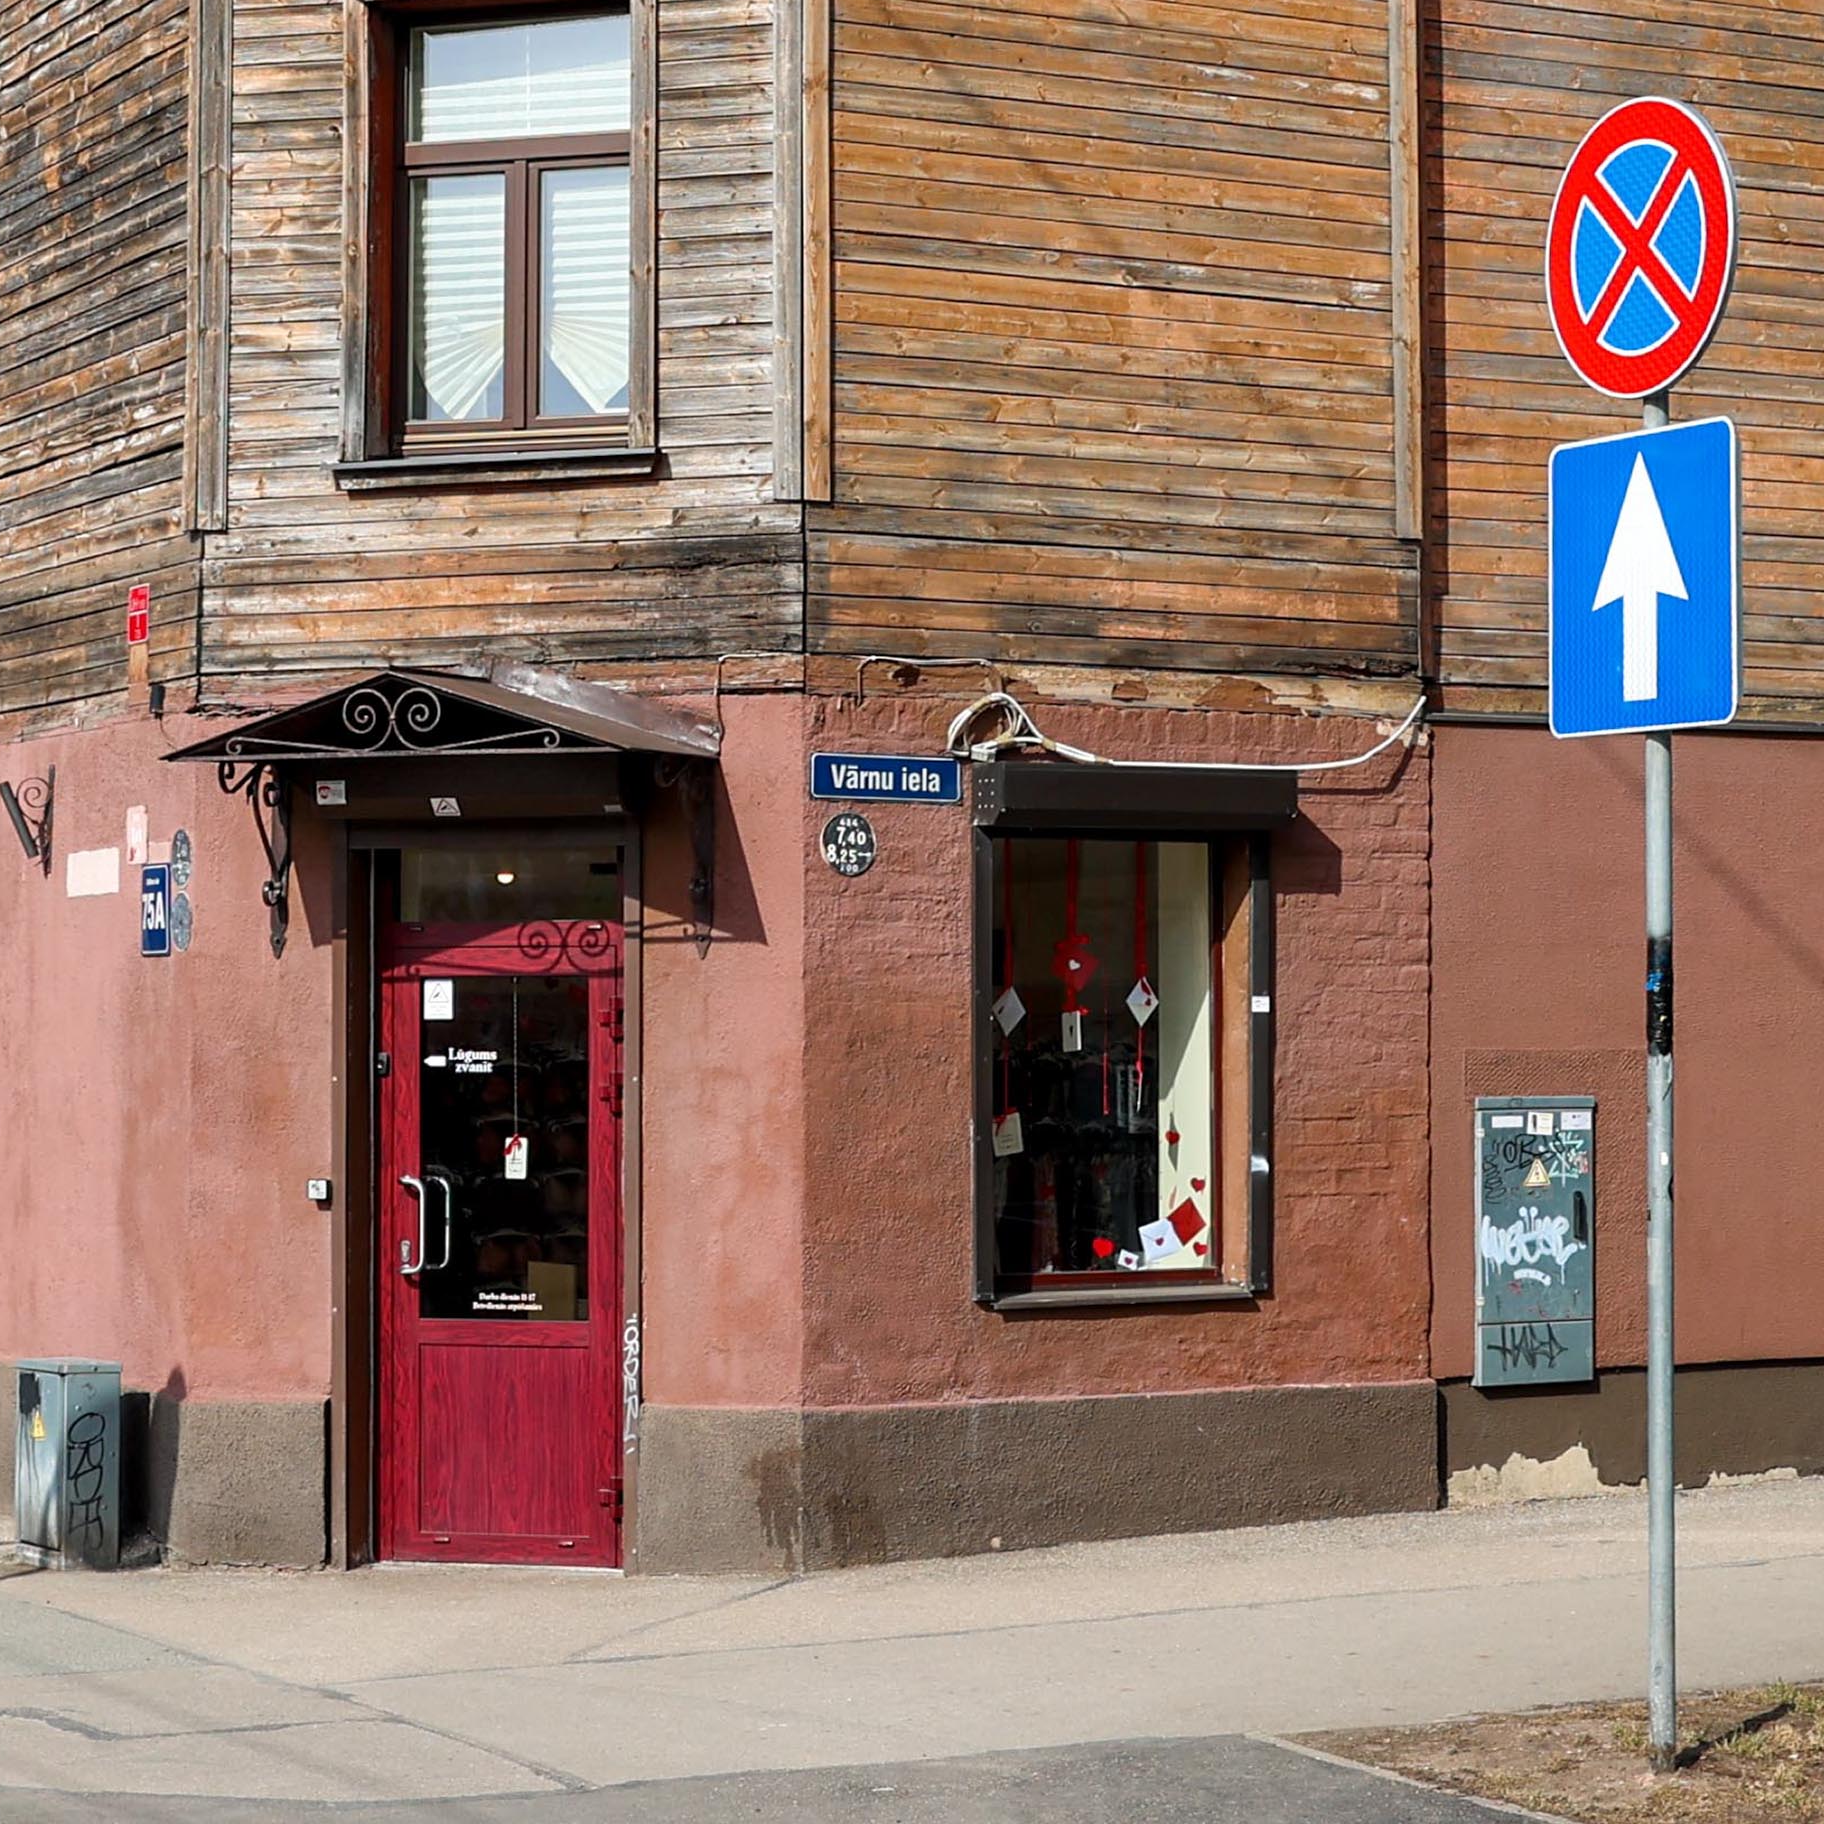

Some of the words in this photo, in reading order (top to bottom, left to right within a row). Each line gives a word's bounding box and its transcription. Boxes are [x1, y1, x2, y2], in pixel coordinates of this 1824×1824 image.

[830, 763, 894, 791] Vārnu
[901, 767, 941, 793] iela
[836, 826, 867, 846] 7,40
[141, 891, 166, 931] 75A
[448, 1047, 498, 1063] Lūgums
[455, 1061, 493, 1073] zvanīt
